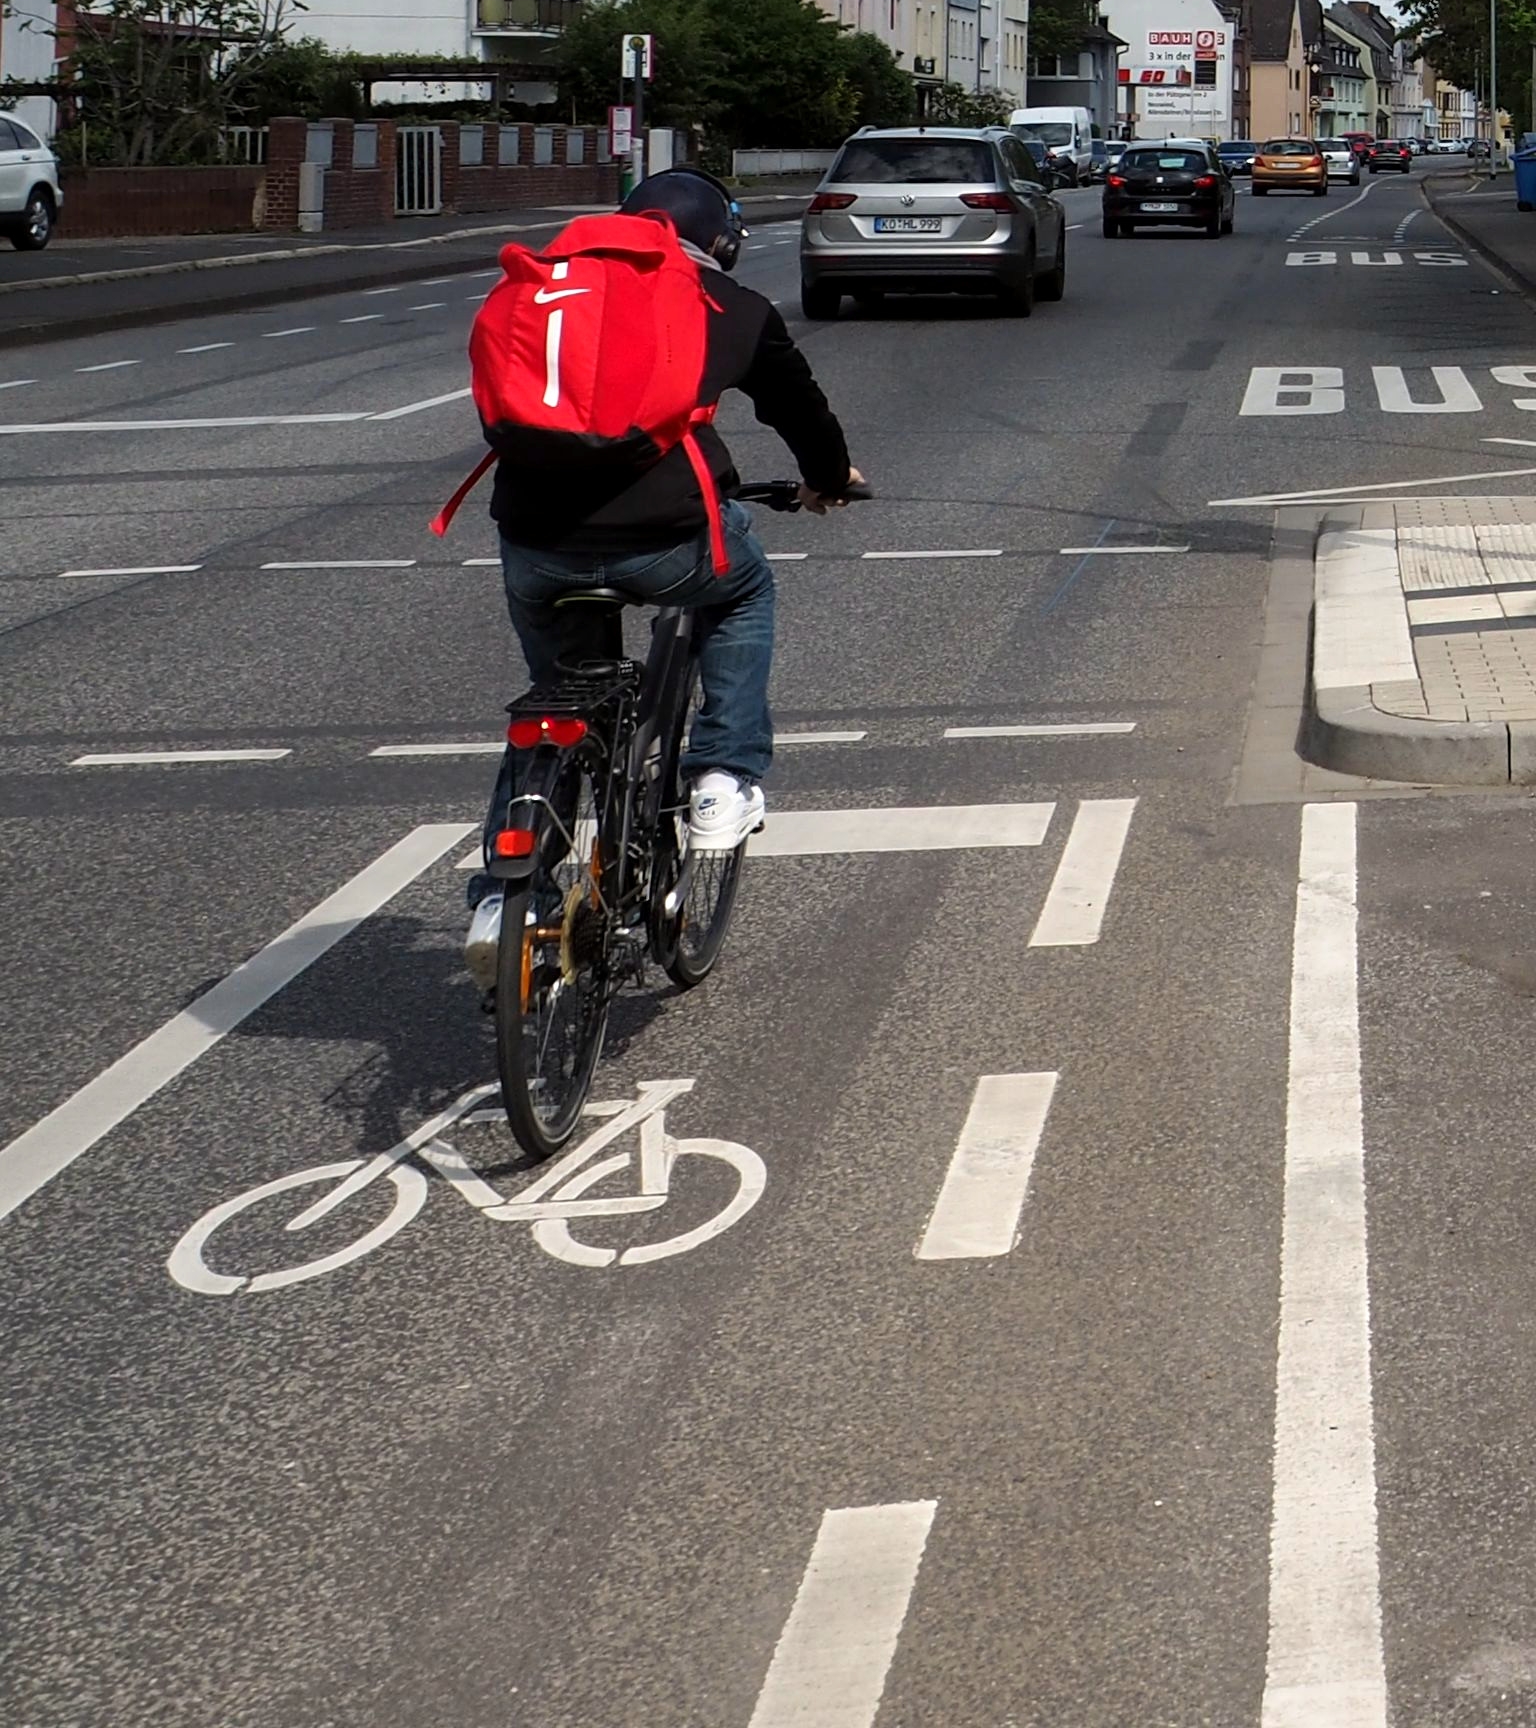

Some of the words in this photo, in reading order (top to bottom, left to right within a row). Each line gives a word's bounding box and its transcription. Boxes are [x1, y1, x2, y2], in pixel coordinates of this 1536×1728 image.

[1149, 32, 1225, 45] BAUHS
[1164, 51, 1174, 60] in
[1176, 51, 1191, 61] der
[920, 219, 940, 229] 999
[1285, 251, 1469, 266] BUS
